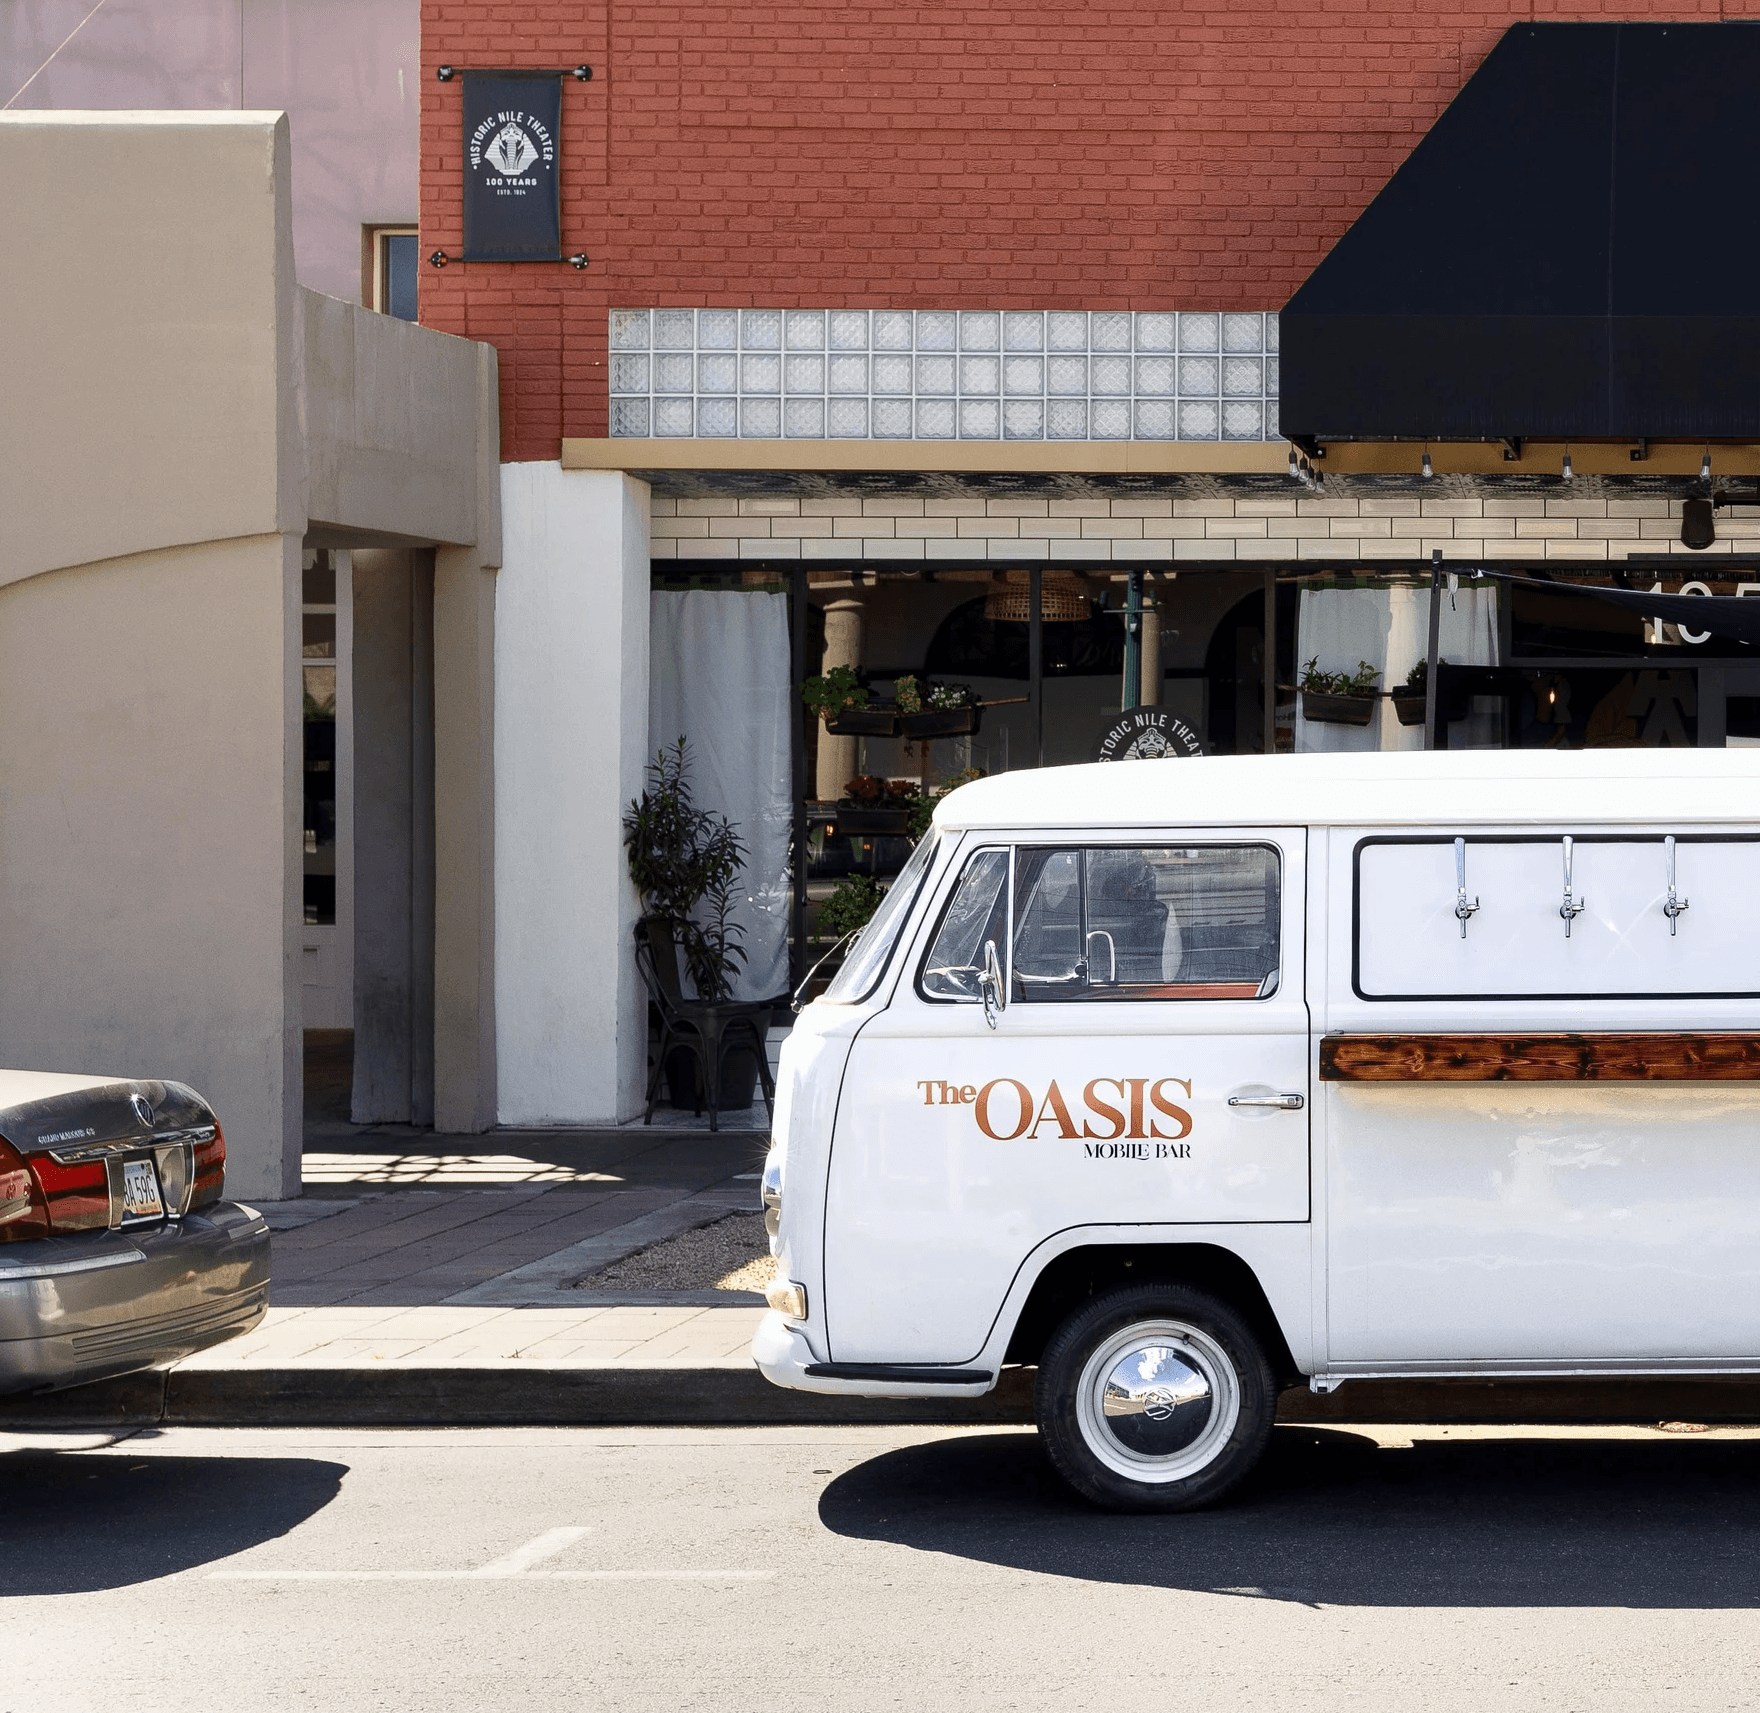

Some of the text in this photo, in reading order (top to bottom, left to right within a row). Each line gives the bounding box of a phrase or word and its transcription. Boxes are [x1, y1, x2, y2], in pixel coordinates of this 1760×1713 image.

[470, 111, 554, 165] HISTORIC NILE THEATER
[486, 178, 537, 186] 100 YEARS
[1099, 713, 1204, 762] STORIC NILE THEAT
[917, 1078, 1193, 1140] The OASIS
[1084, 1143, 1192, 1160] MOBILE BAR
